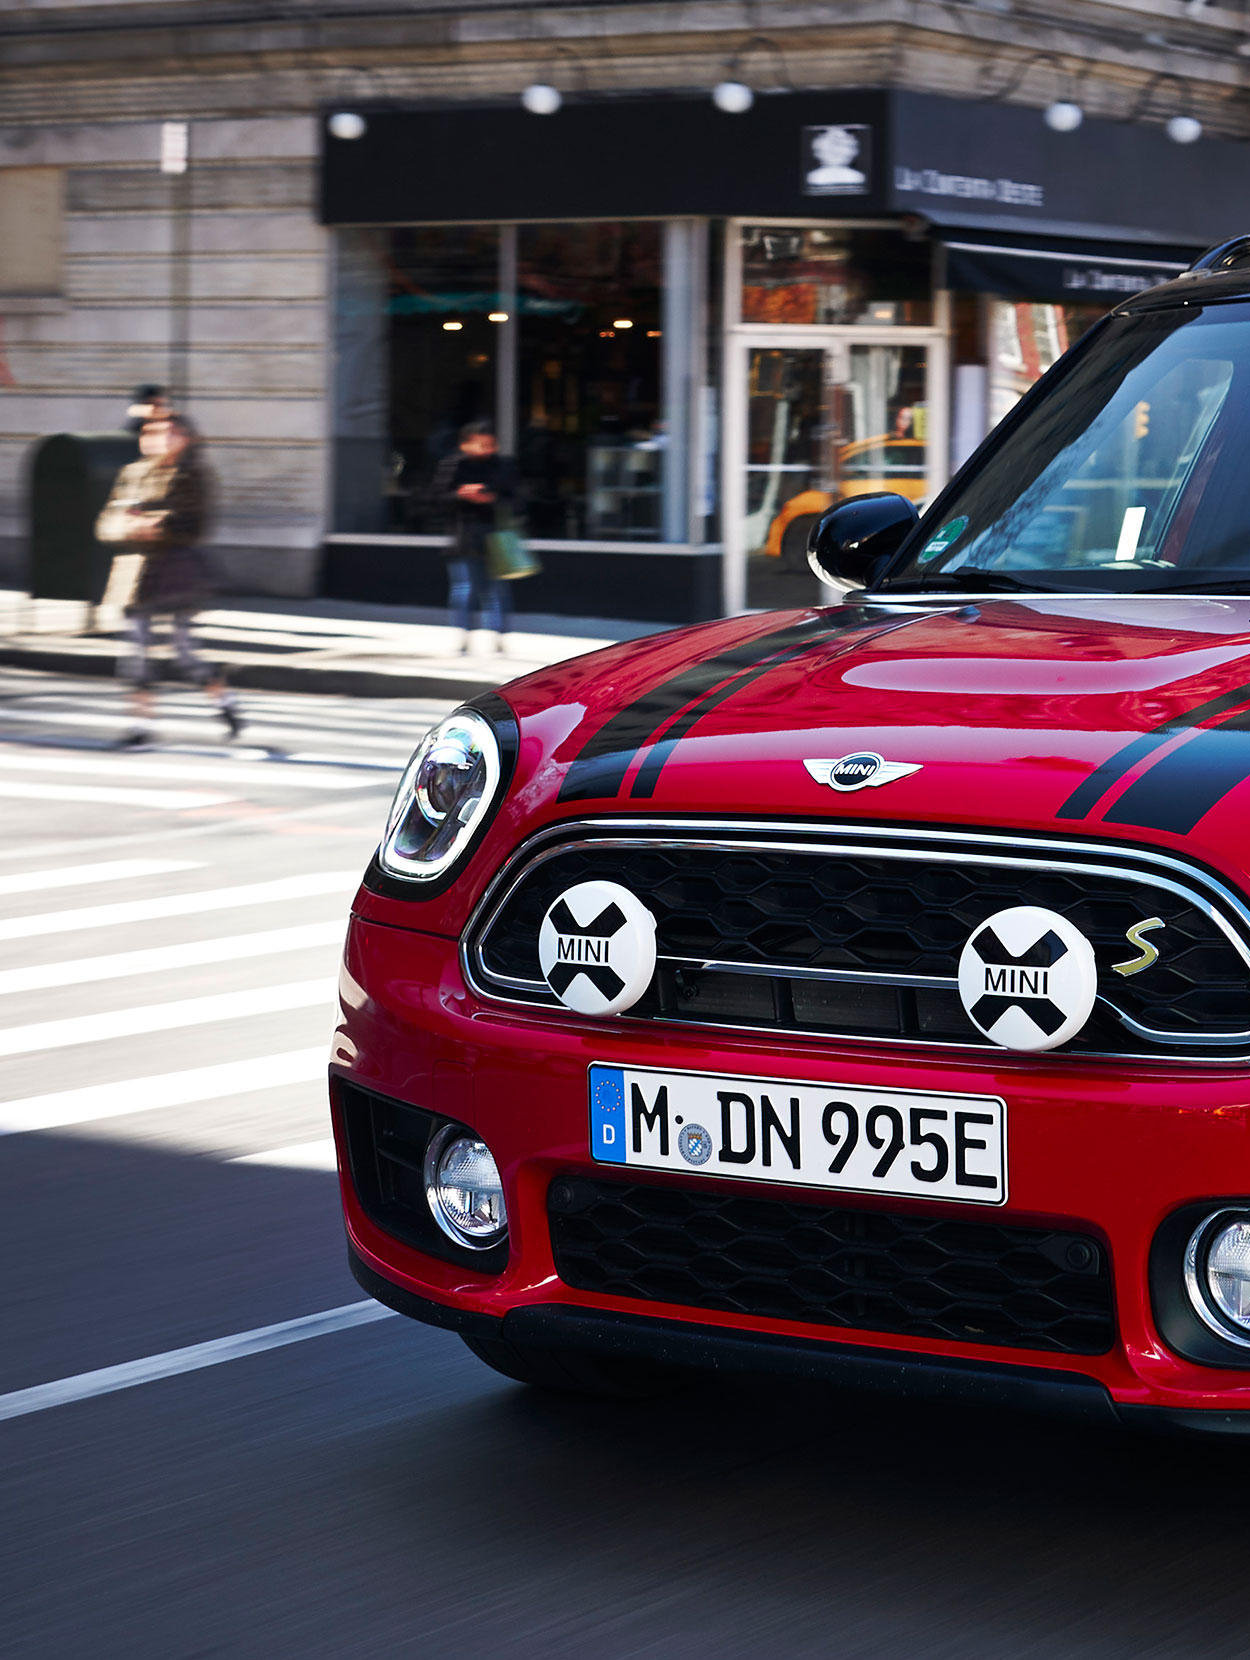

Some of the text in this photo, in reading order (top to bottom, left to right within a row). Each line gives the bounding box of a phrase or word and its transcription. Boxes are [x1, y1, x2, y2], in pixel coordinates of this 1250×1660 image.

[835, 763, 876, 776] MINI
[557, 937, 609, 963] MINI
[1111, 917, 1166, 977] S
[985, 967, 1048, 995] MINI
[602, 1123, 616, 1145] D
[716, 1091, 801, 1170] DN
[821, 1101, 998, 1189] 995E
